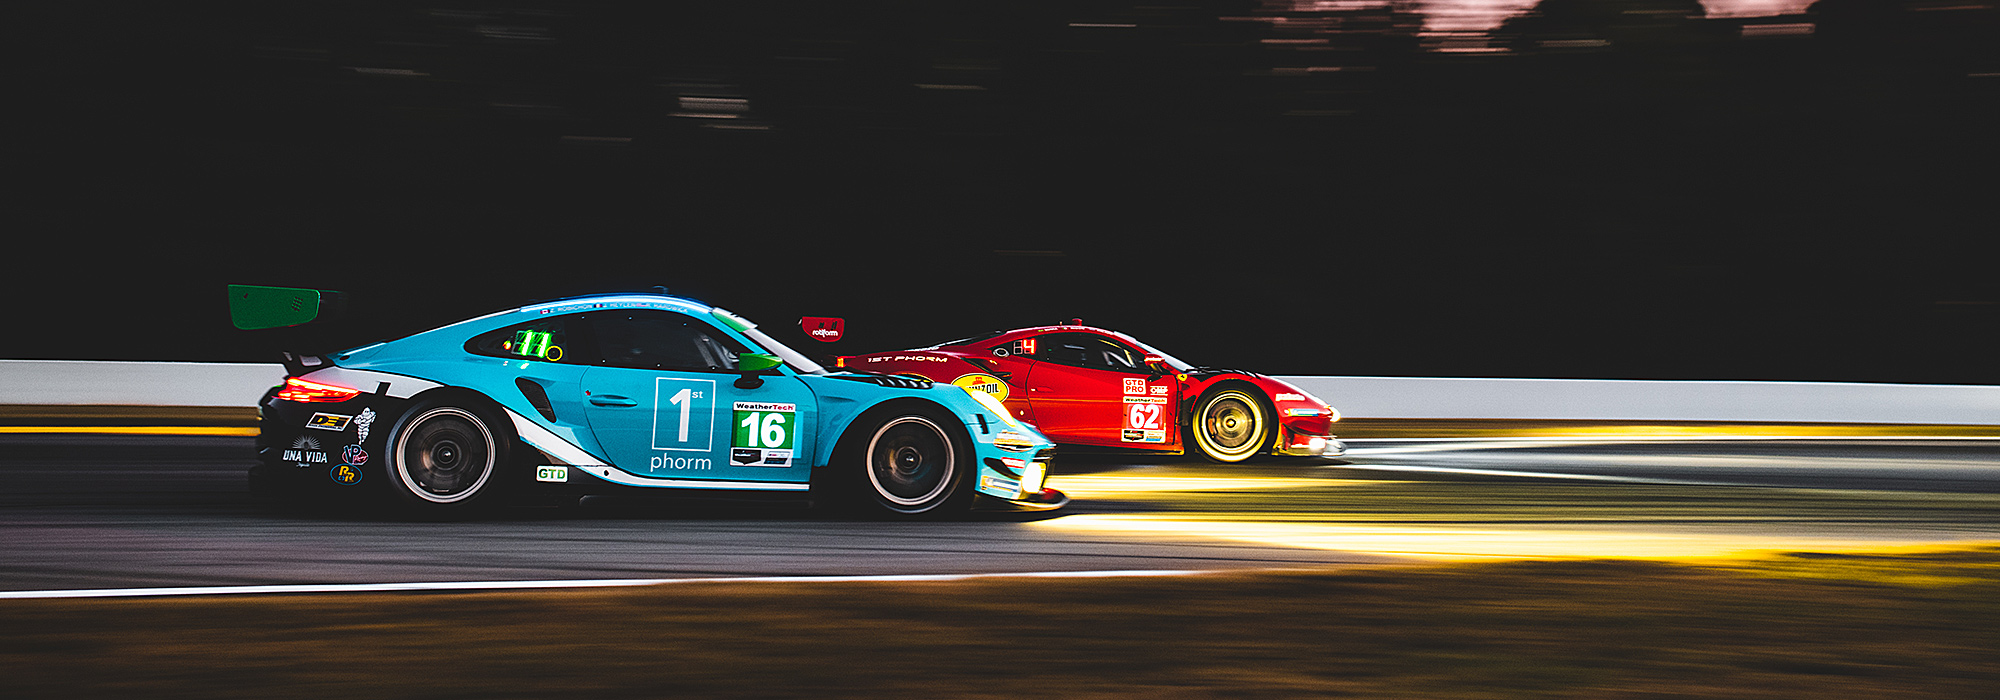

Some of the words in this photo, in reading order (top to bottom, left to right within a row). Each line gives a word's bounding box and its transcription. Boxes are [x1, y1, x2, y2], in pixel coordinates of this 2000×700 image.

[894, 355, 948, 363] PHORM
[1125, 385, 1144, 393] PRO
[736, 403, 794, 411] WeatherTech
[1130, 403, 1160, 429] 62
[741, 411, 786, 449] 16
[282, 449, 302, 462] UNA
[306, 451, 328, 463] VIDA
[650, 452, 712, 473] phorm
[538, 468, 566, 479] GTD
